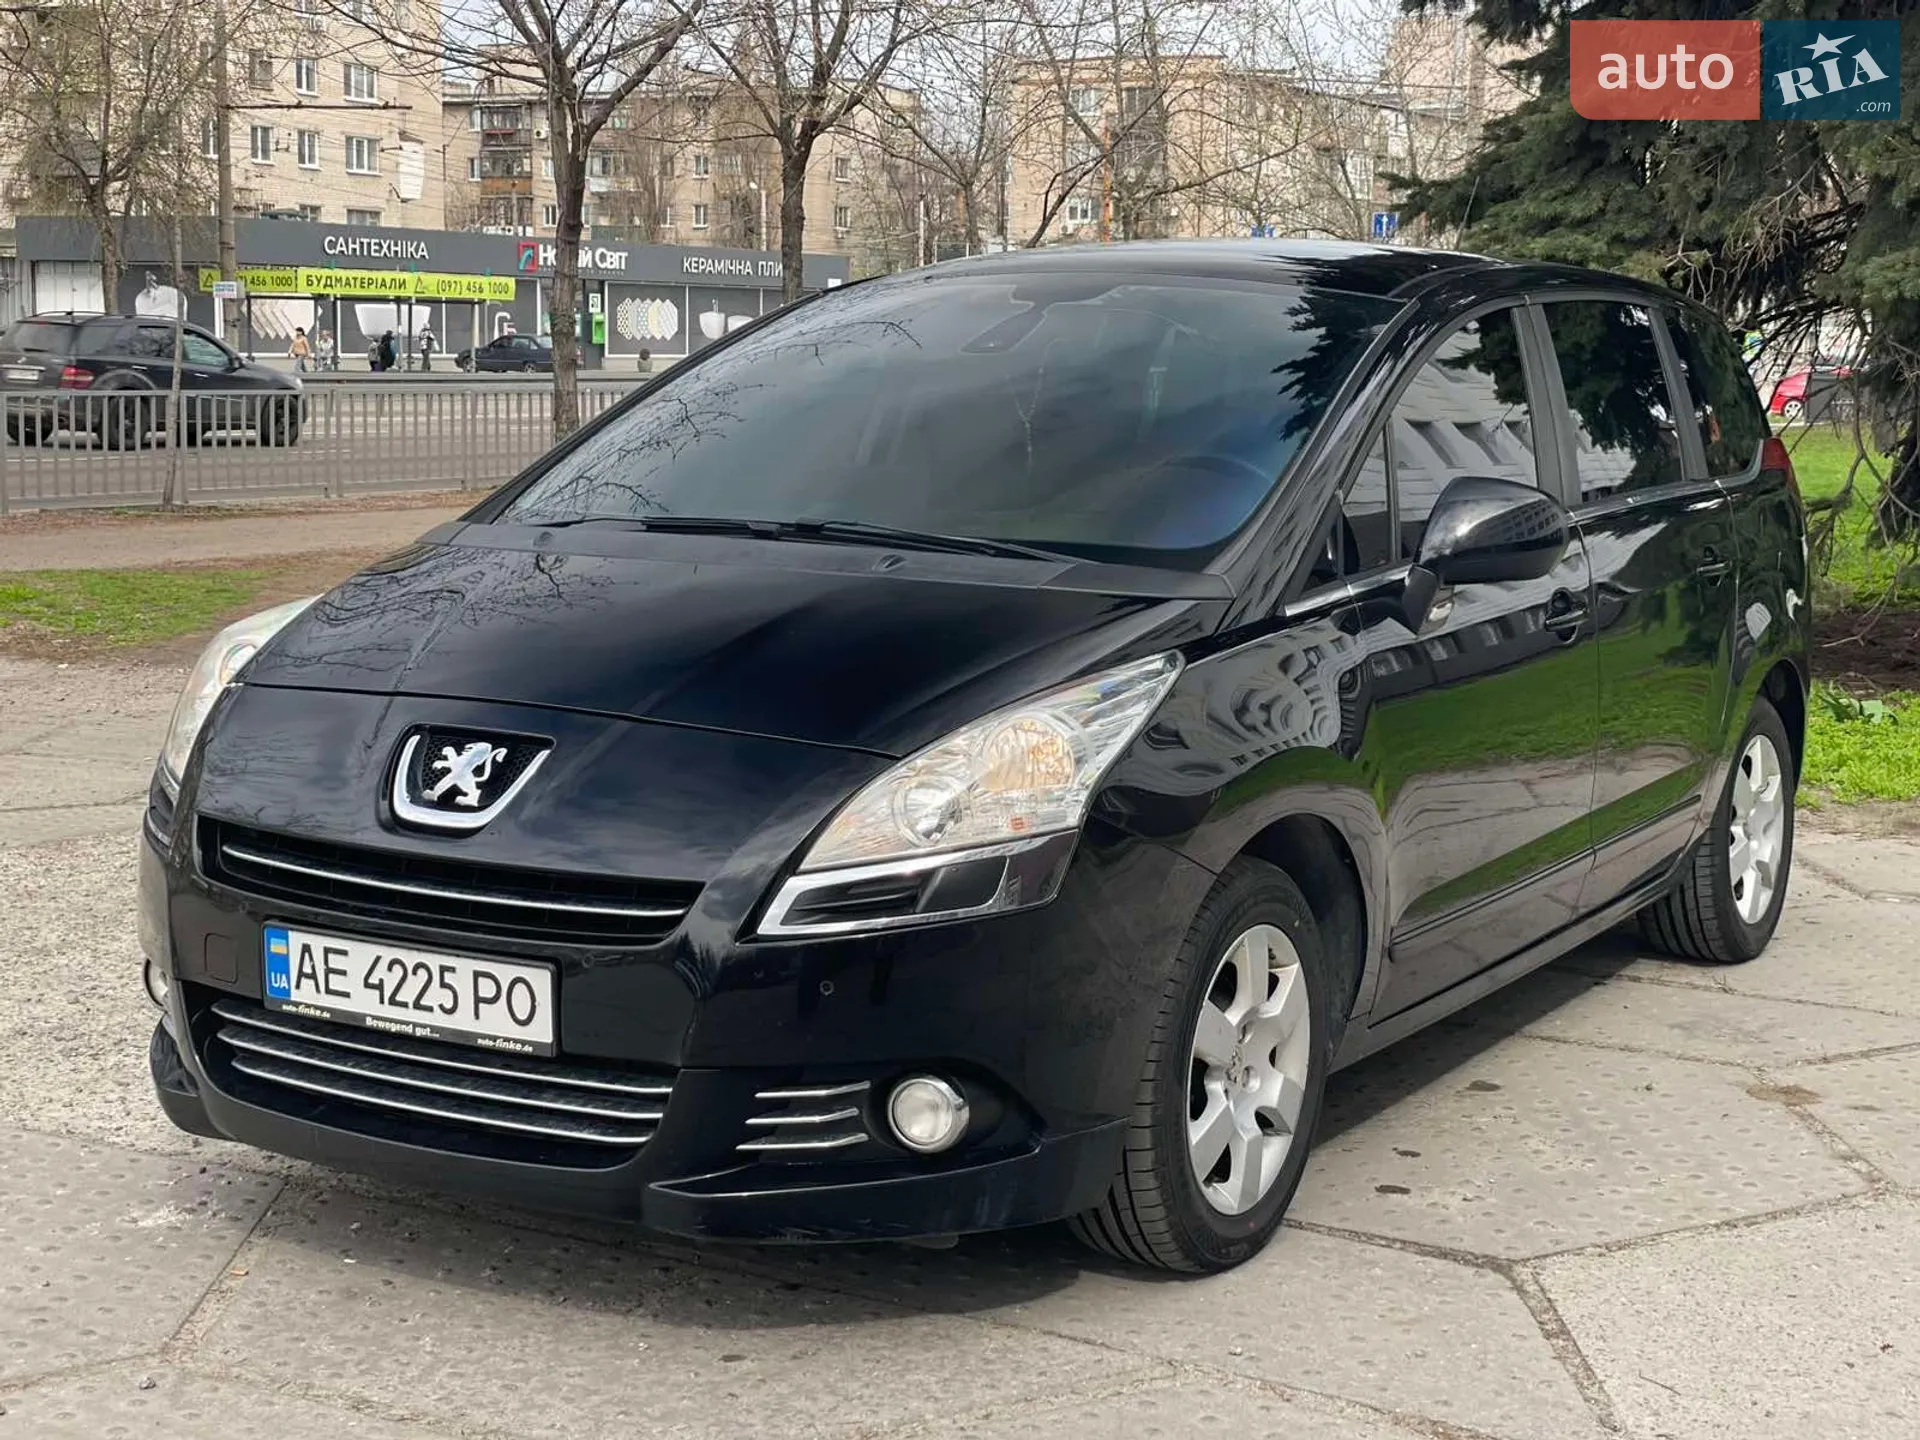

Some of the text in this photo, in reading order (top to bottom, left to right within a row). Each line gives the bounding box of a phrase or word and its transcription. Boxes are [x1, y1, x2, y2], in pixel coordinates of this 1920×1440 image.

[323, 235, 430, 260] САНТЕХНІКА
[683, 256, 784, 278] КЕРАМІЧНА ПЛИ
[249, 276, 266, 287] 456
[271, 275, 293, 287] 1000
[306, 273, 407, 290] БУДМАТЕРІАЛИ
[436, 279, 509, 295] (097) 456 1000
[271, 971, 289, 989] UA
[295, 943, 537, 1027] AE 4225 PO
[366, 1016, 413, 1033] Bewegend
